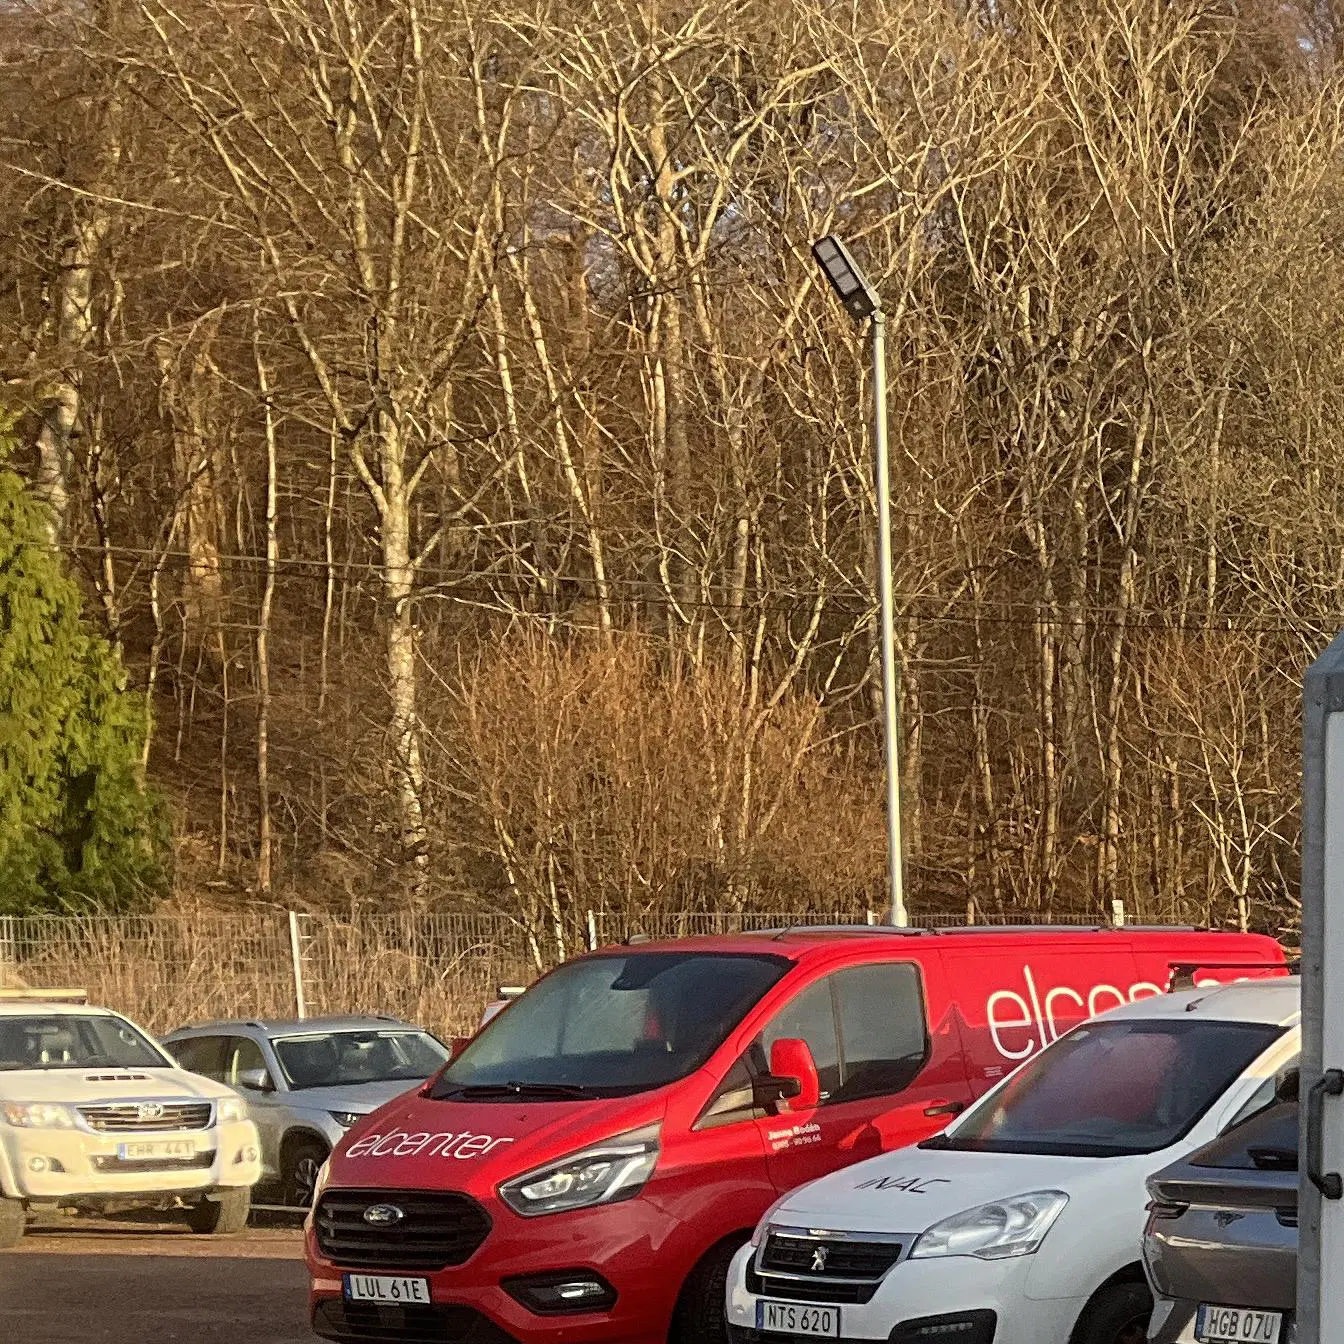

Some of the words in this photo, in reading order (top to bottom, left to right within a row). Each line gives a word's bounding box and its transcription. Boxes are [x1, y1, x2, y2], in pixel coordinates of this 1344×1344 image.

[346, 1127, 514, 1160] elcenter
[355, 1277, 386, 1298] LUL
[391, 1279, 422, 1300] 61E
[768, 1304, 796, 1329] NTS
[800, 1309, 831, 1333] 620
[1208, 1309, 1239, 1337] HGB
[1243, 1313, 1275, 1340] 07U
